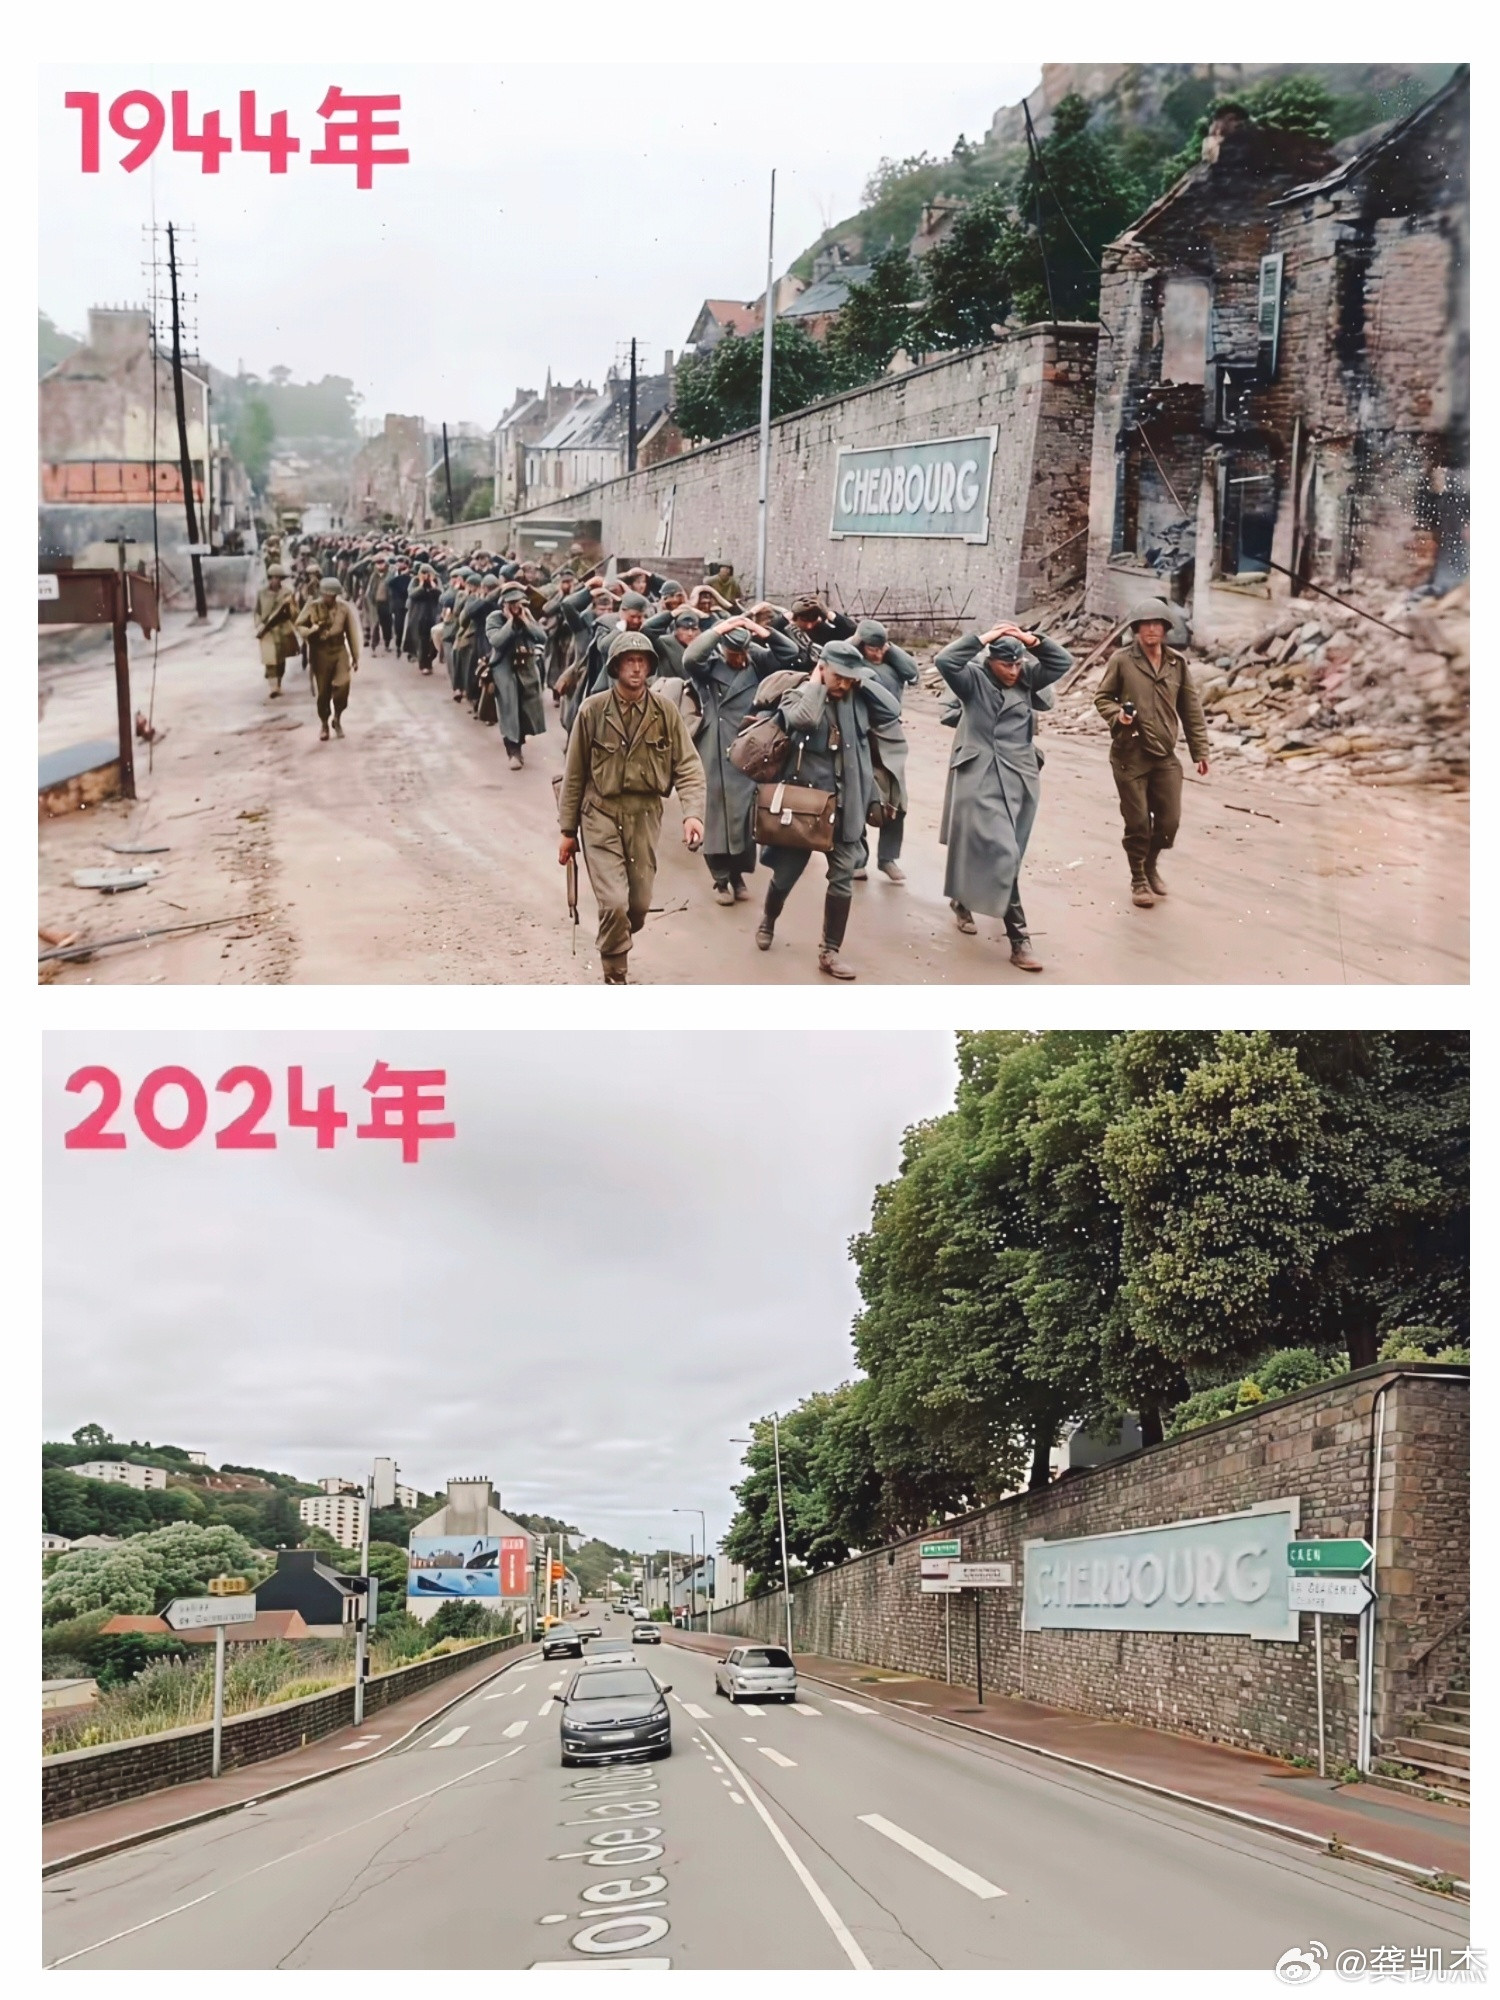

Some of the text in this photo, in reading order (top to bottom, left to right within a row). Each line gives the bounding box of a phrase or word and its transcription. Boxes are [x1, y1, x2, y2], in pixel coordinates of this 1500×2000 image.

[840, 460, 980, 515] CHERBOURG
[1035, 1547, 1271, 1607] CHERBOURG
[1289, 1548, 1321, 1561] CAEN
